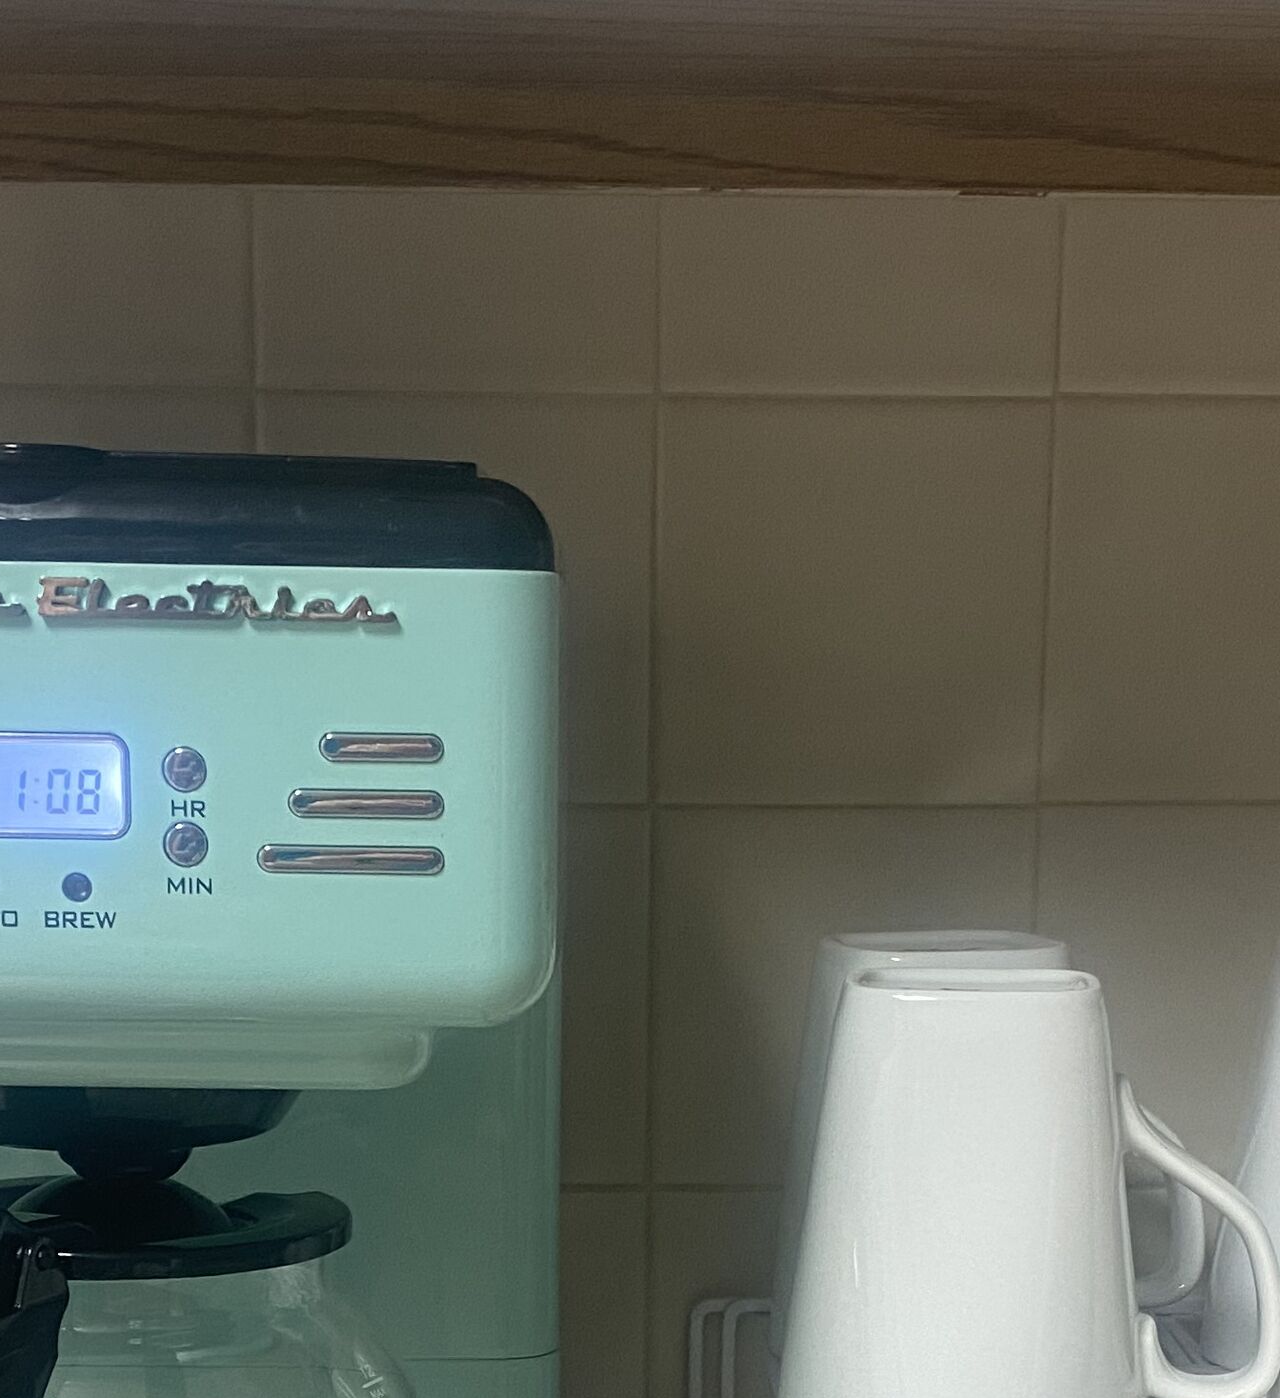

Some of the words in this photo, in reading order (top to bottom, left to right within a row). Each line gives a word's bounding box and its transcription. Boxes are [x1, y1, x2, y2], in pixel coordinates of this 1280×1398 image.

[37, 577, 401, 629] Electrics
[170, 799, 206, 818] HR
[166, 876, 213, 896] MIN
[43, 910, 117, 929] BREW
